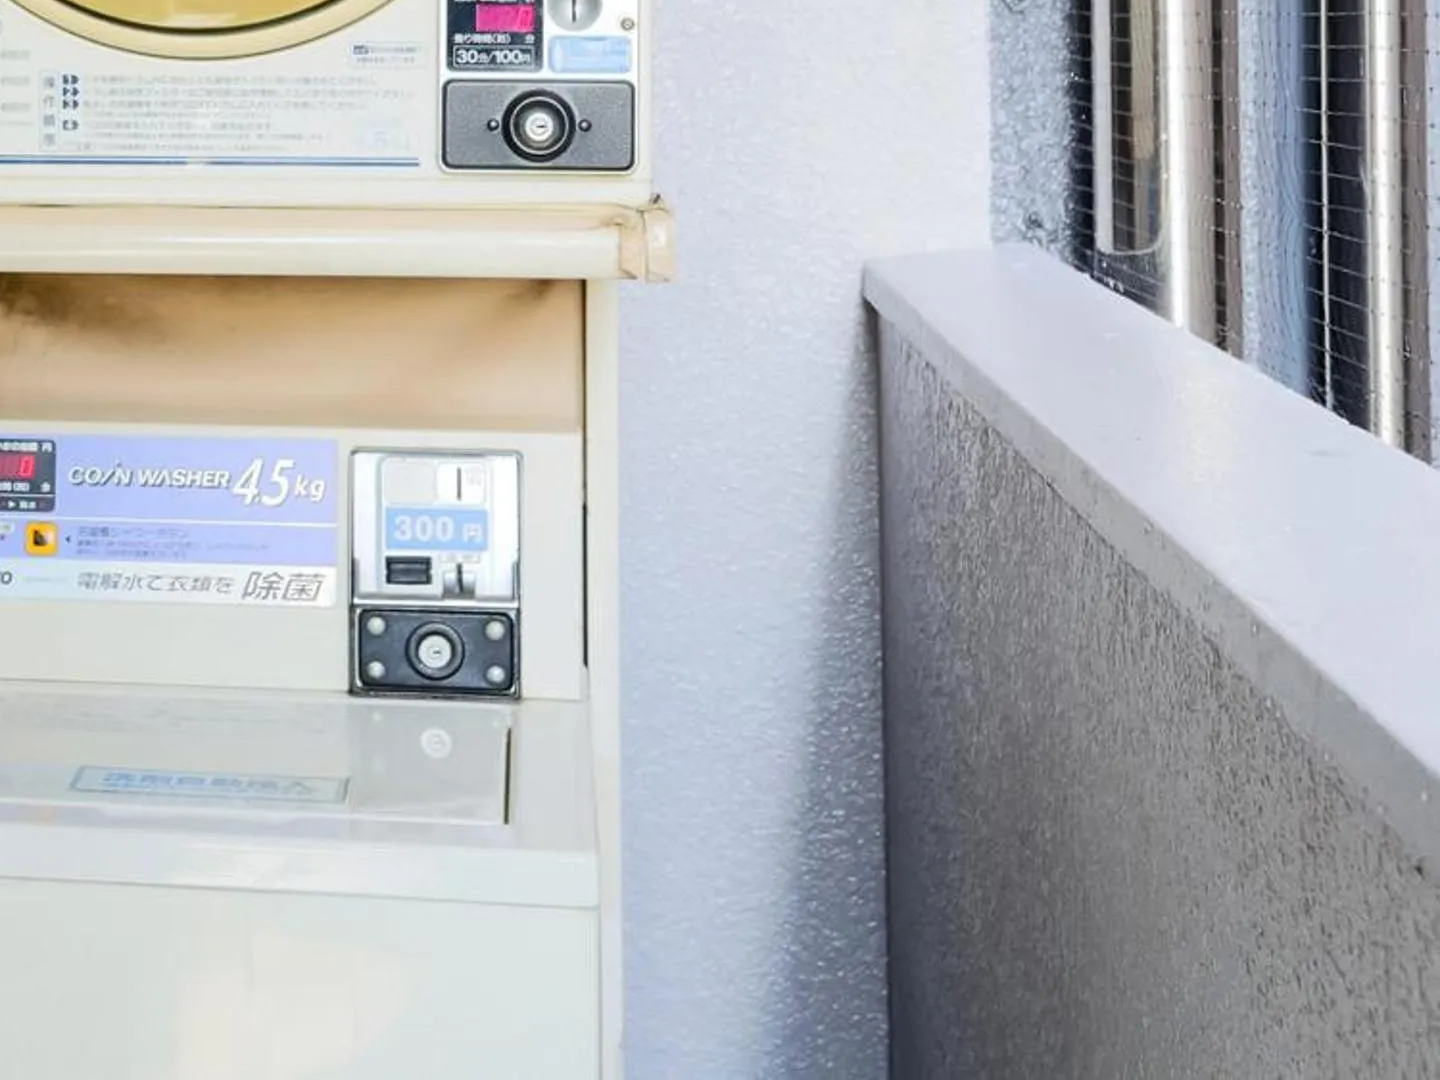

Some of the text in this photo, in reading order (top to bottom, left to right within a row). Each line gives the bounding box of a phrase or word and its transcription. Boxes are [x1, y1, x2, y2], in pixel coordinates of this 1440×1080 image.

[138, 468, 233, 489] WASHER
[294, 473, 327, 503] kg
[392, 514, 455, 542] 300
